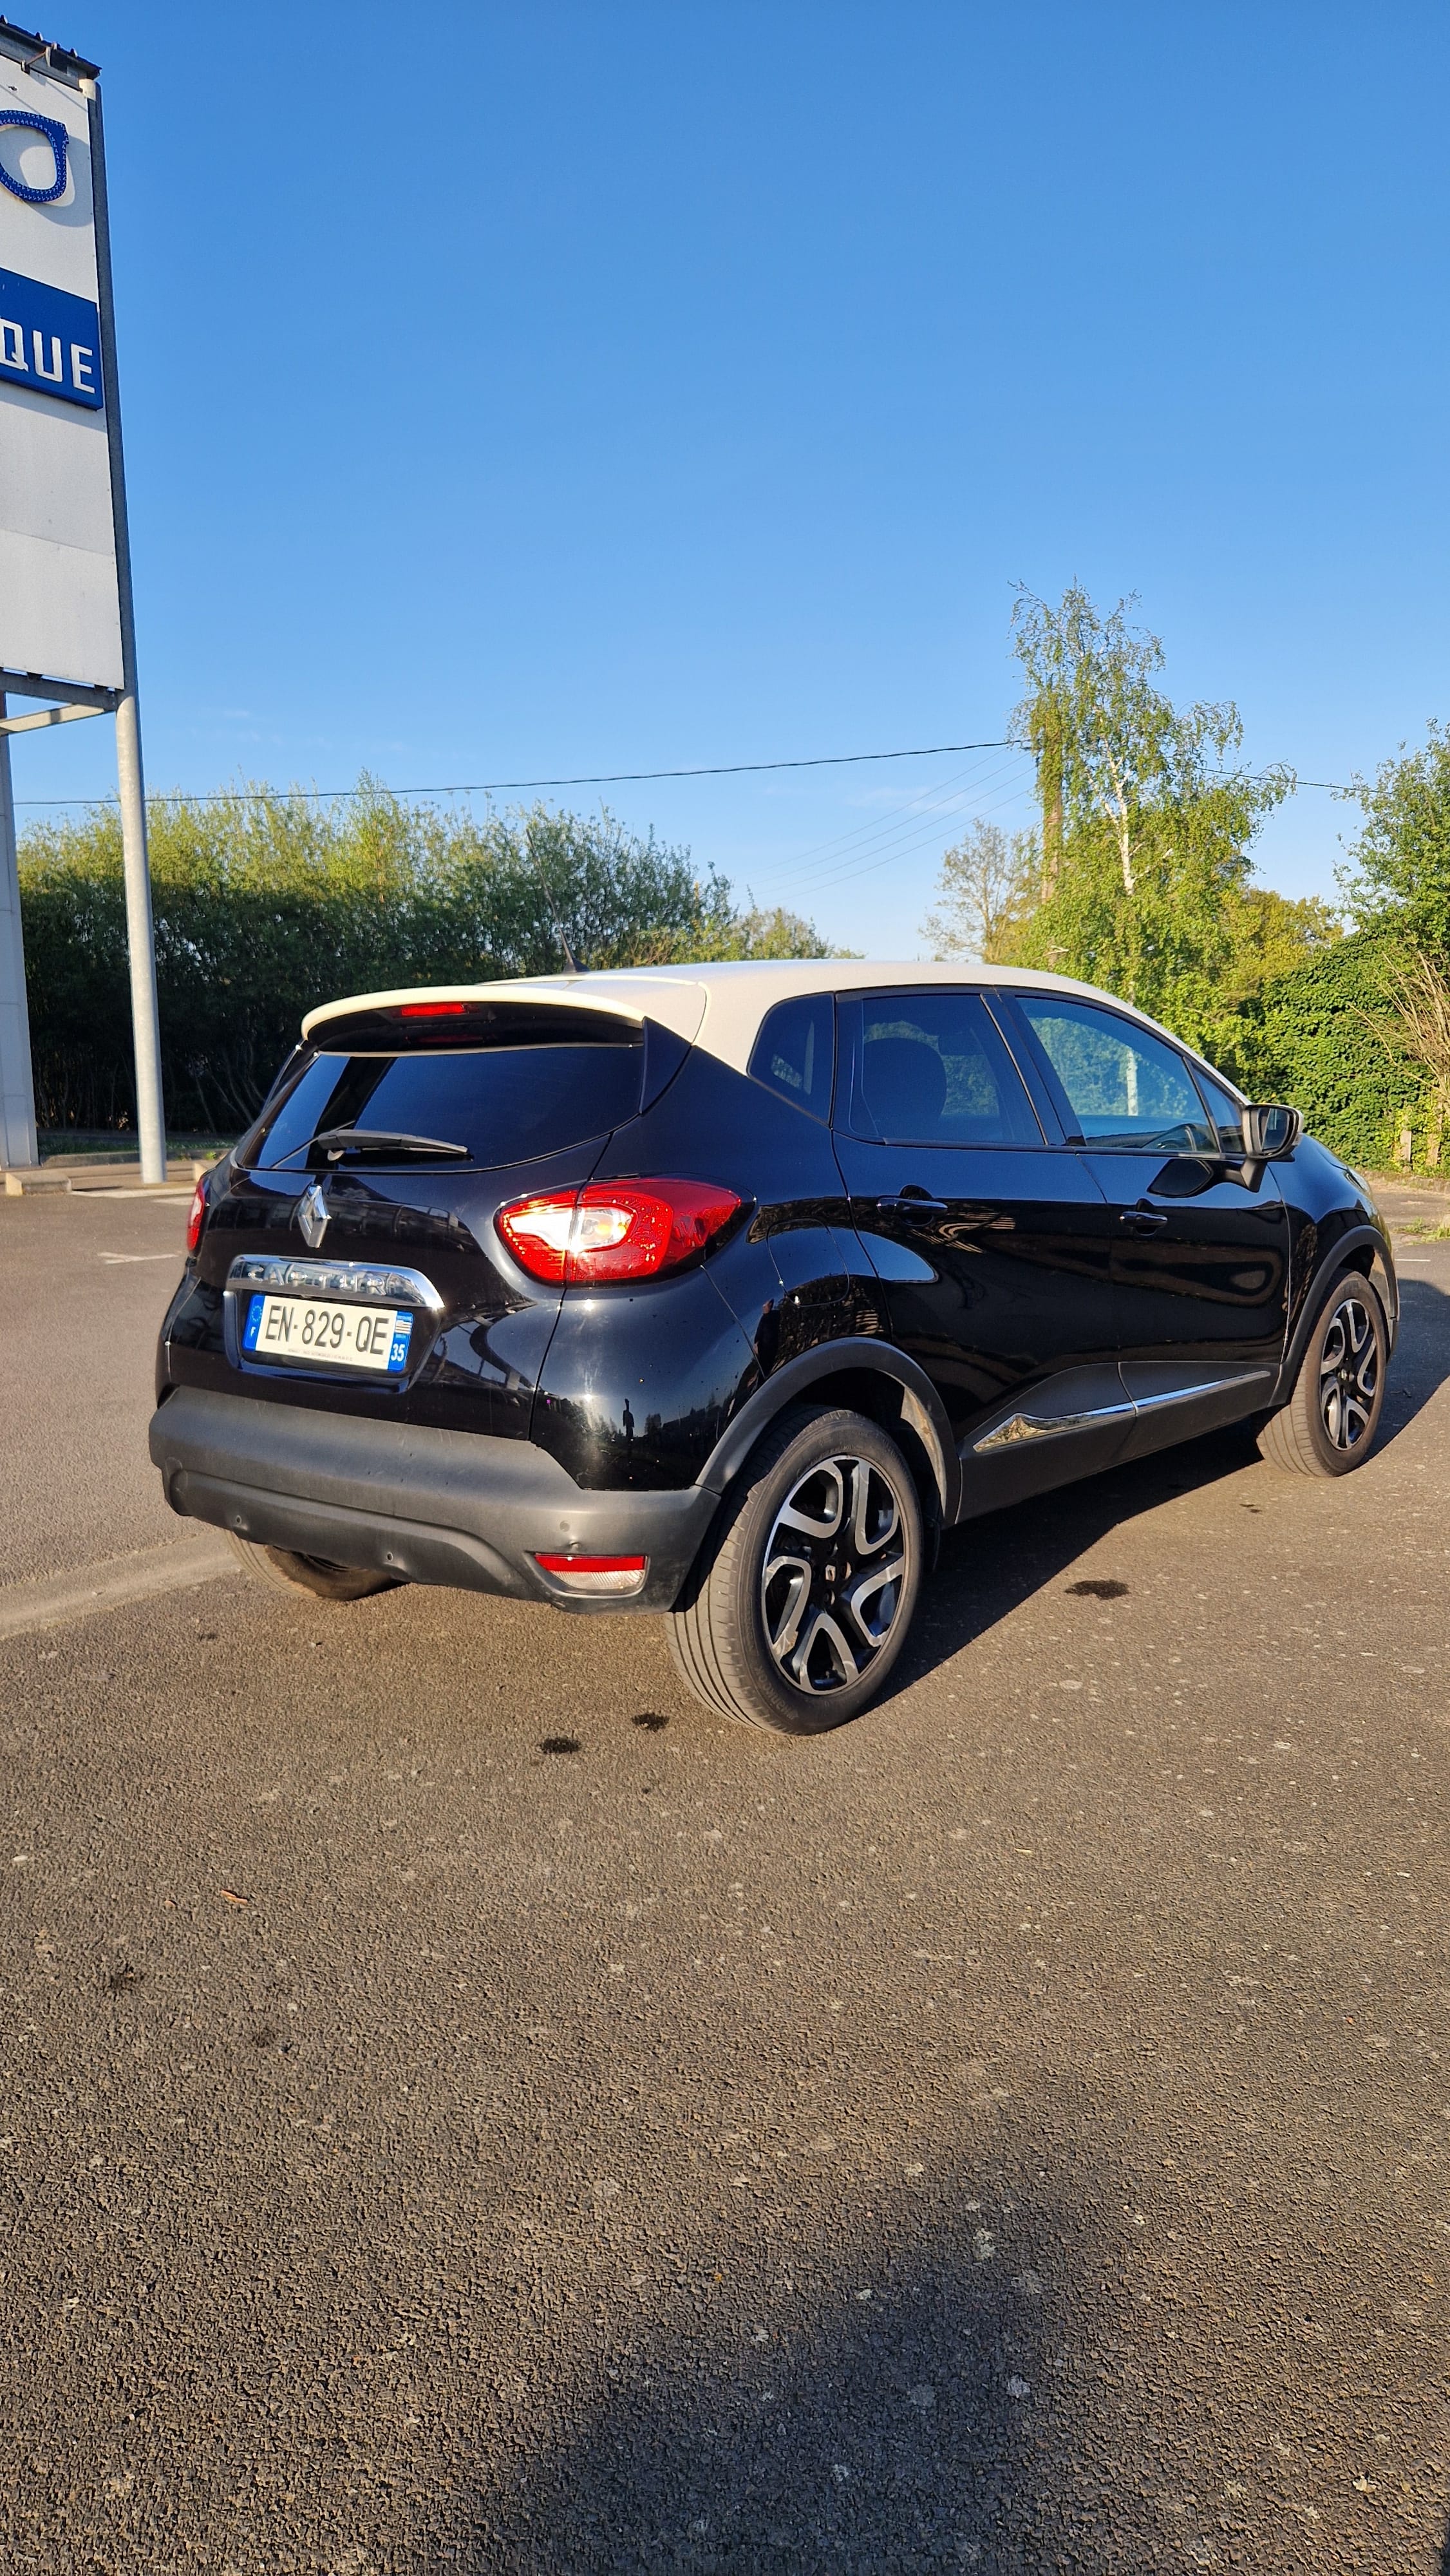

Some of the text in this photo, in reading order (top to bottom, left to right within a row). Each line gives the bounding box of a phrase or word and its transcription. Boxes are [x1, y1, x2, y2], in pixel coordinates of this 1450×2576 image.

[0, 317, 95, 393] QUE
[248, 1265, 386, 1295] CAPTUR
[391, 1343, 406, 1361] 35
